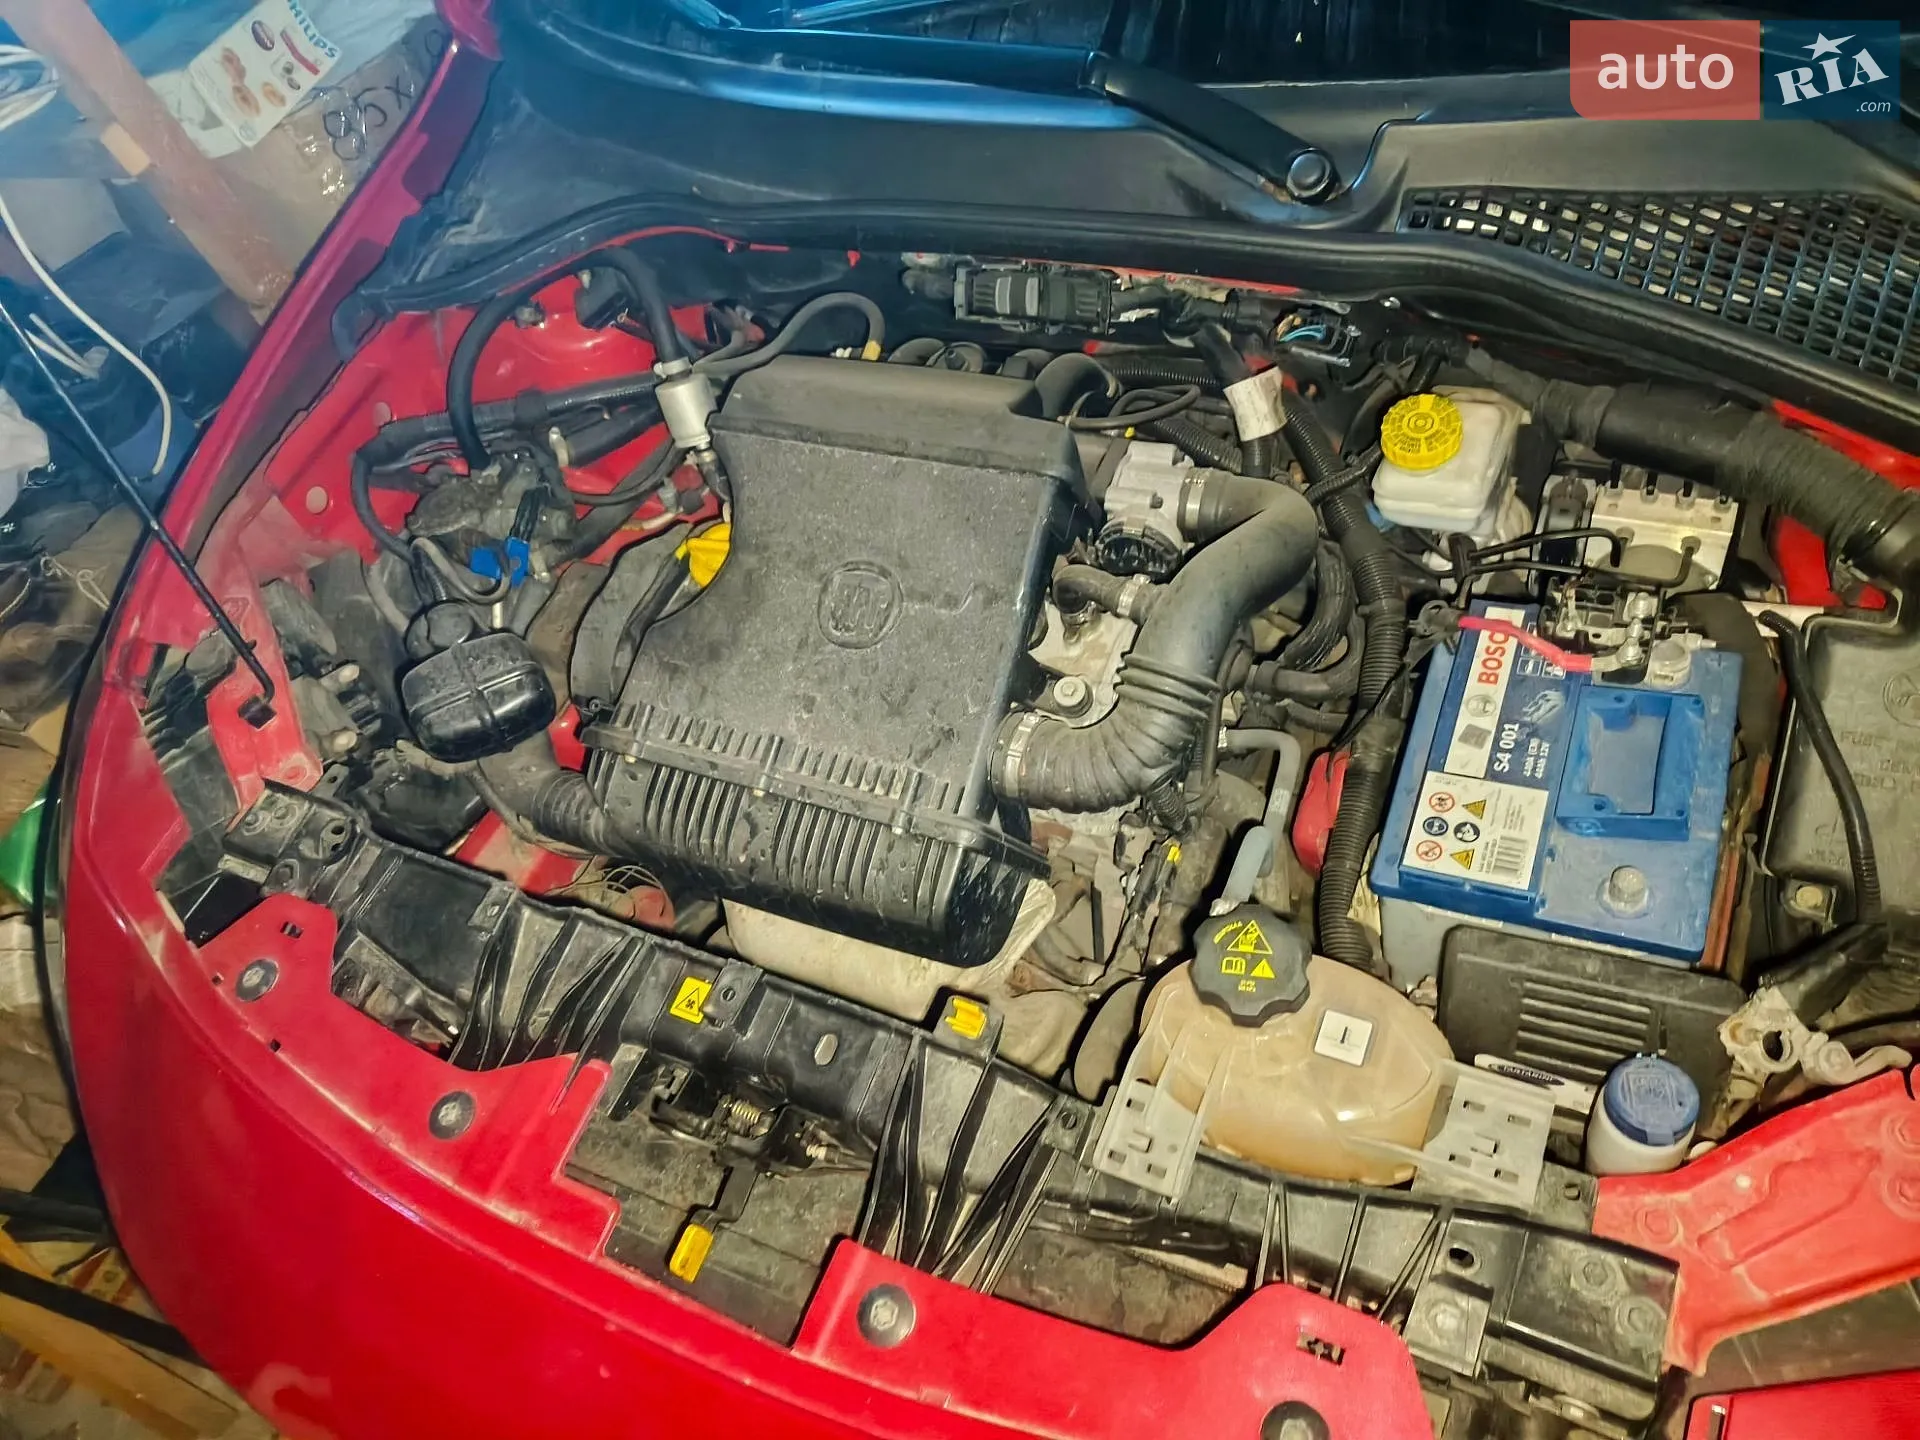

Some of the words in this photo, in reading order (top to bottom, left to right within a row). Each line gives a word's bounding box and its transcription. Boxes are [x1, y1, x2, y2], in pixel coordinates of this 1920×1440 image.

[287, 0, 338, 58] HILIPS
[1477, 628, 1510, 686] BOSC
[1498, 722, 1520, 750] 001
[1493, 752, 1513, 774] S4
